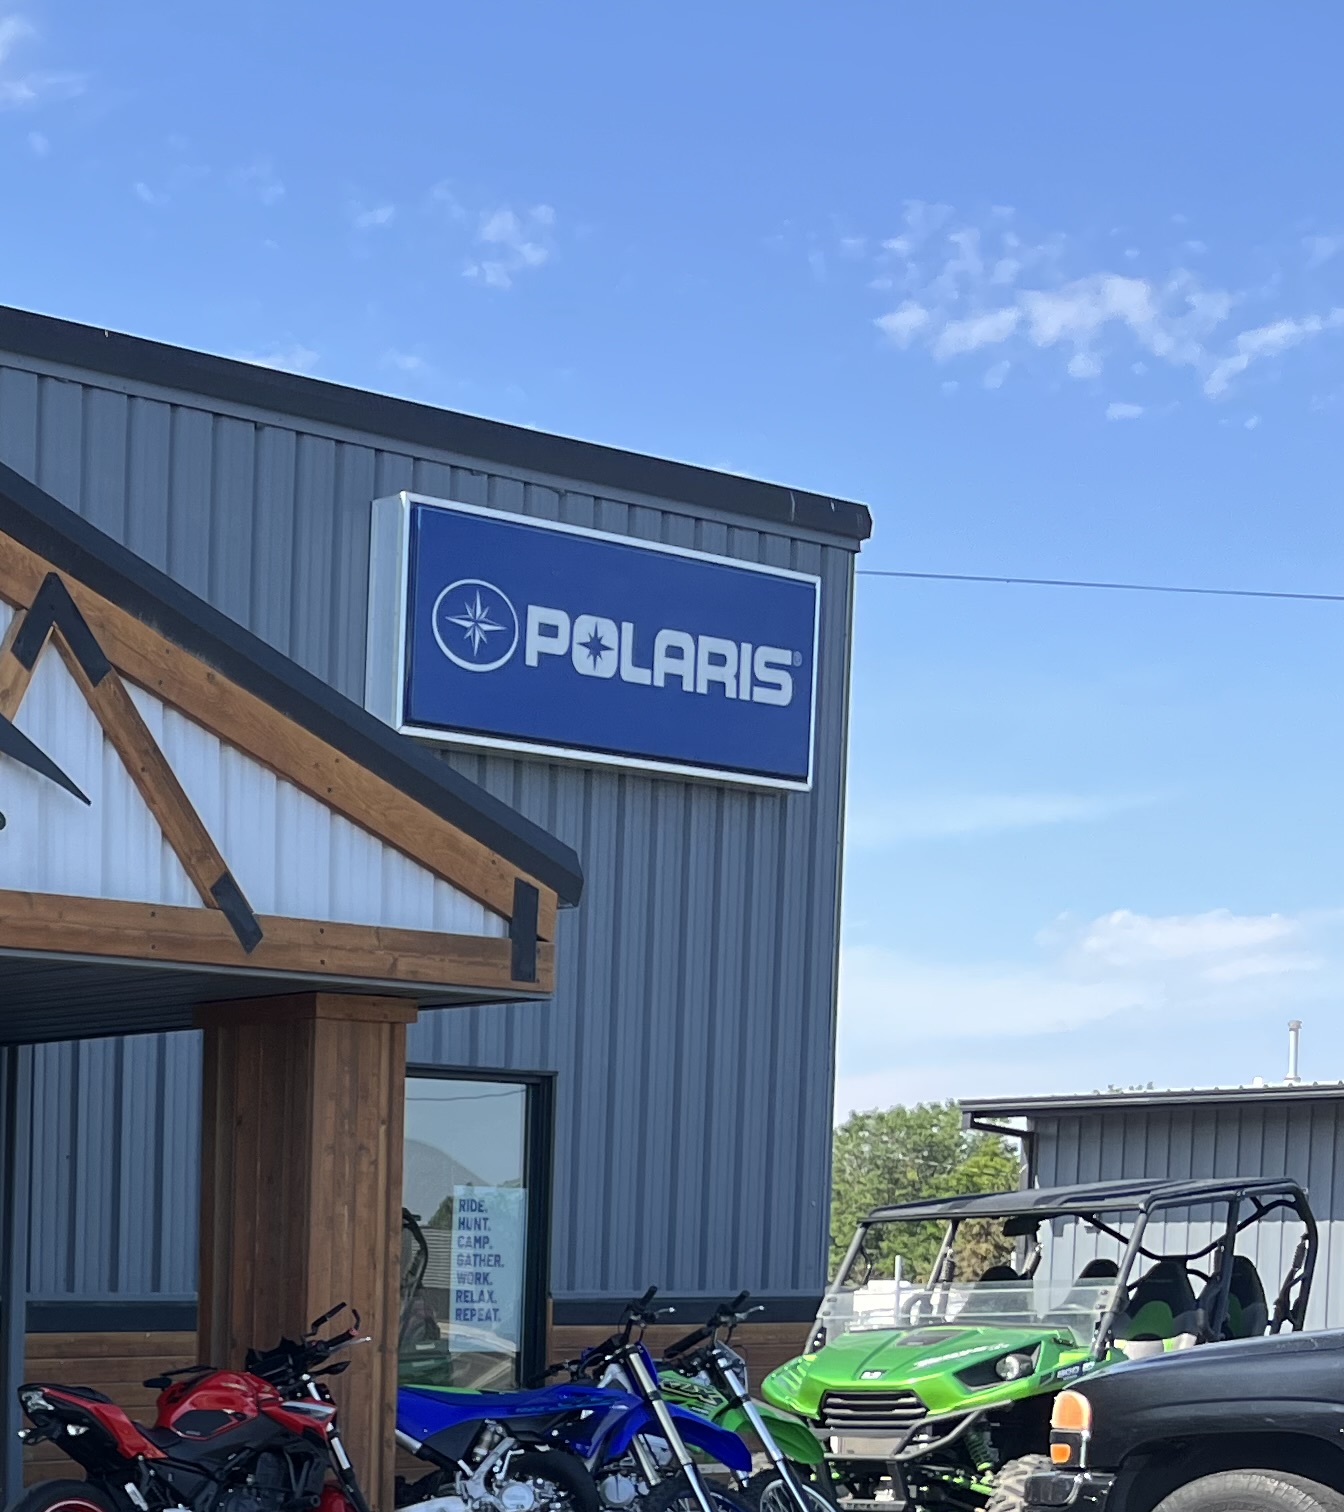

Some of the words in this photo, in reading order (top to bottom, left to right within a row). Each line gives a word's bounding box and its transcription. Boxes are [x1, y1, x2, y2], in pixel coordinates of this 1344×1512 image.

[525, 605, 794, 707] POLARIS
[458, 1199, 489, 1214] RIDE.
[458, 1217, 491, 1232] HUNT.
[457, 1235, 493, 1250] CAMP.
[456, 1254, 505, 1269] GATHER.
[456, 1272, 493, 1286] WORK.
[455, 1290, 497, 1305] RELAX.
[455, 1307, 501, 1322] REPEAT.
